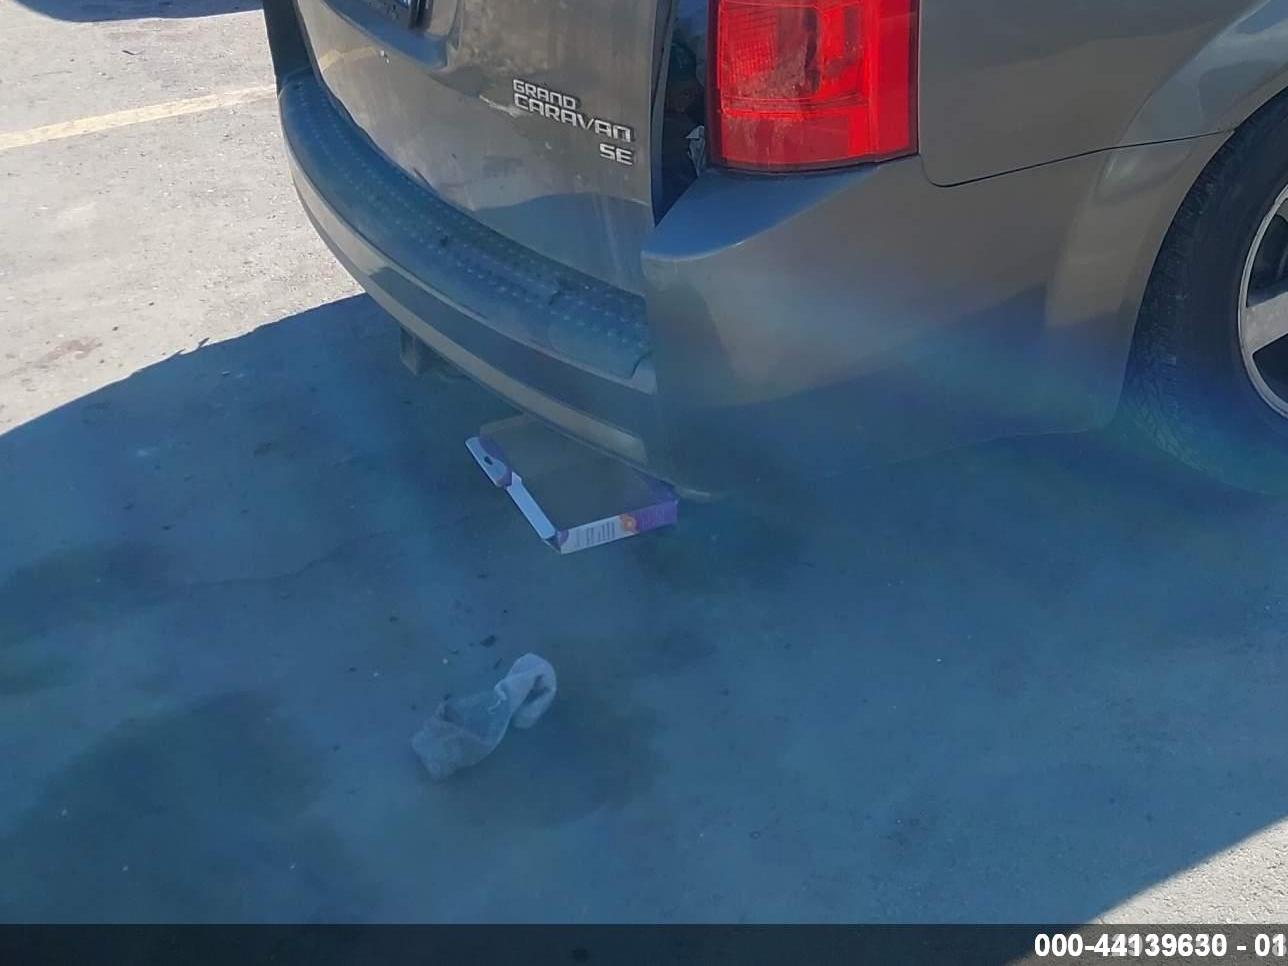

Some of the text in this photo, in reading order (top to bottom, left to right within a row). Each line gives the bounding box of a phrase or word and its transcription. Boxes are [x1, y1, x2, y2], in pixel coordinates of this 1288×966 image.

[513, 79, 577, 111] GRAND
[514, 93, 632, 143] CARAVAN
[600, 143, 633, 166] SE
